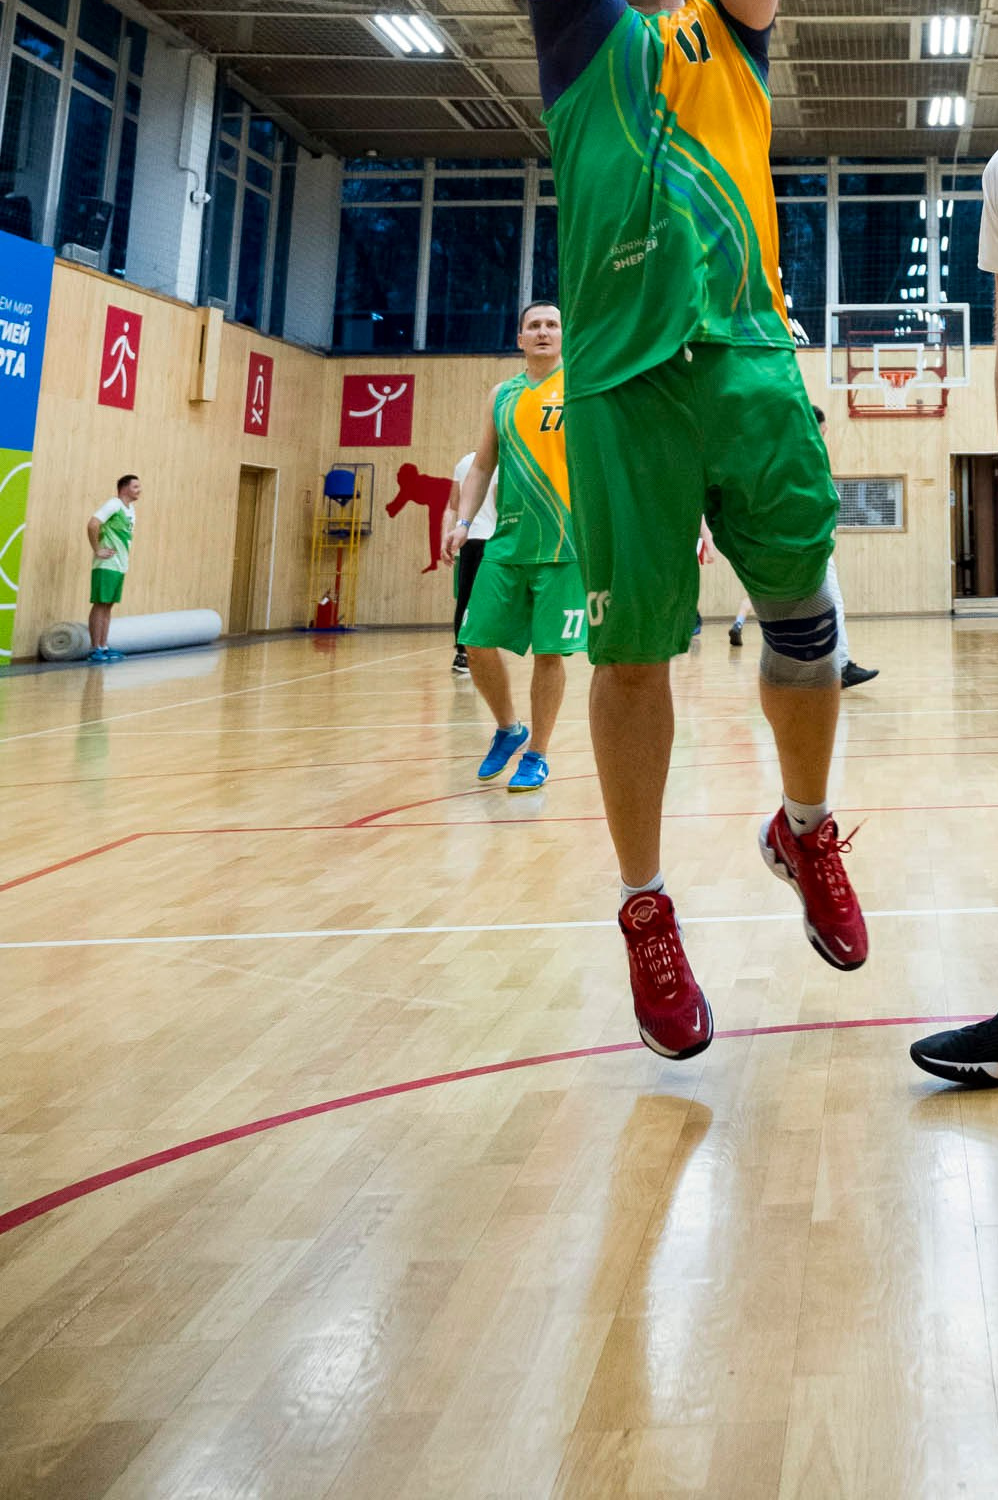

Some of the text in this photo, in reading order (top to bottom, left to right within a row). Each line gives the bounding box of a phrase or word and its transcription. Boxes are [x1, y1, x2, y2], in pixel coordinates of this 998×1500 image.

[675, 18, 713, 64] 11
[539, 405, 564, 433] 27
[561, 609, 585, 639] 27
